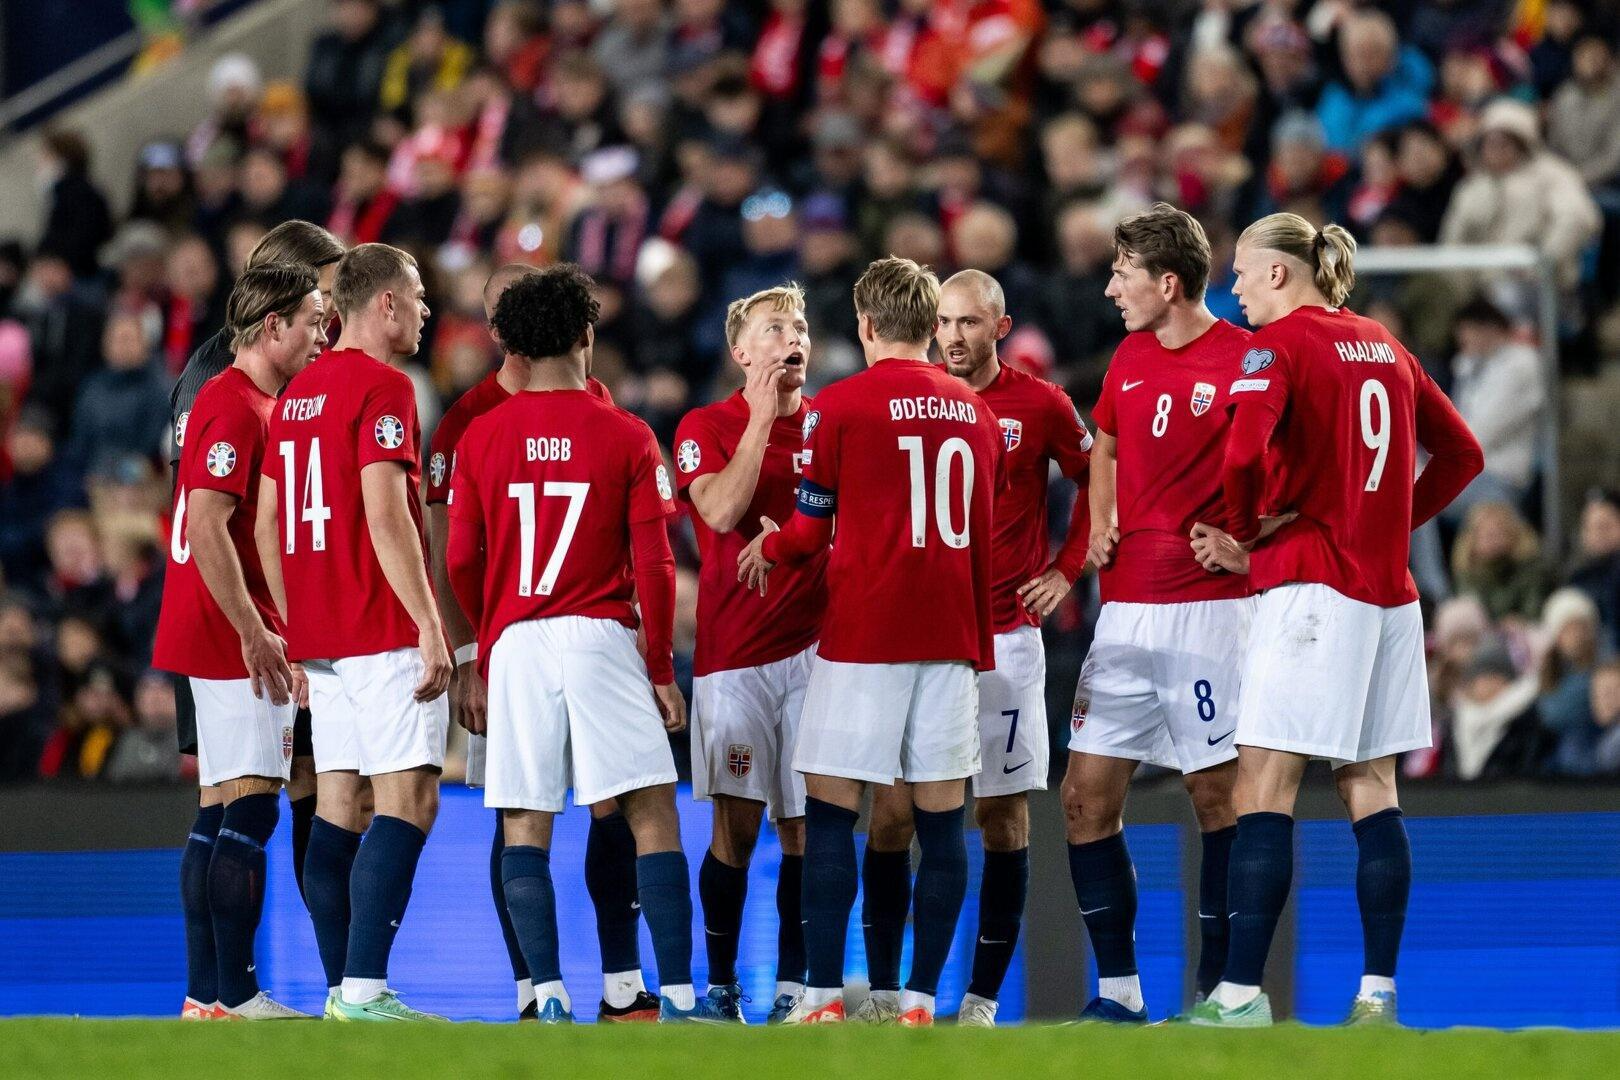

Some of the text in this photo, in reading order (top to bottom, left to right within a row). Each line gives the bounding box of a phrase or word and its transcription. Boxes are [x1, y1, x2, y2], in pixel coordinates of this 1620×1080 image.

[1334, 340, 1396, 364] HAALAND
[889, 396, 977, 424] ØDEGAARD
[1152, 393, 1172, 438] 8
[526, 437, 571, 462] BOBB
[1360, 378, 1390, 491] 9
[279, 437, 331, 555] 14
[808, 495, 835, 505] RESPE
[897, 436, 975, 549] 10
[508, 481, 590, 597] 17
[1194, 679, 1216, 722] 8
[1001, 708, 1019, 753] 7
